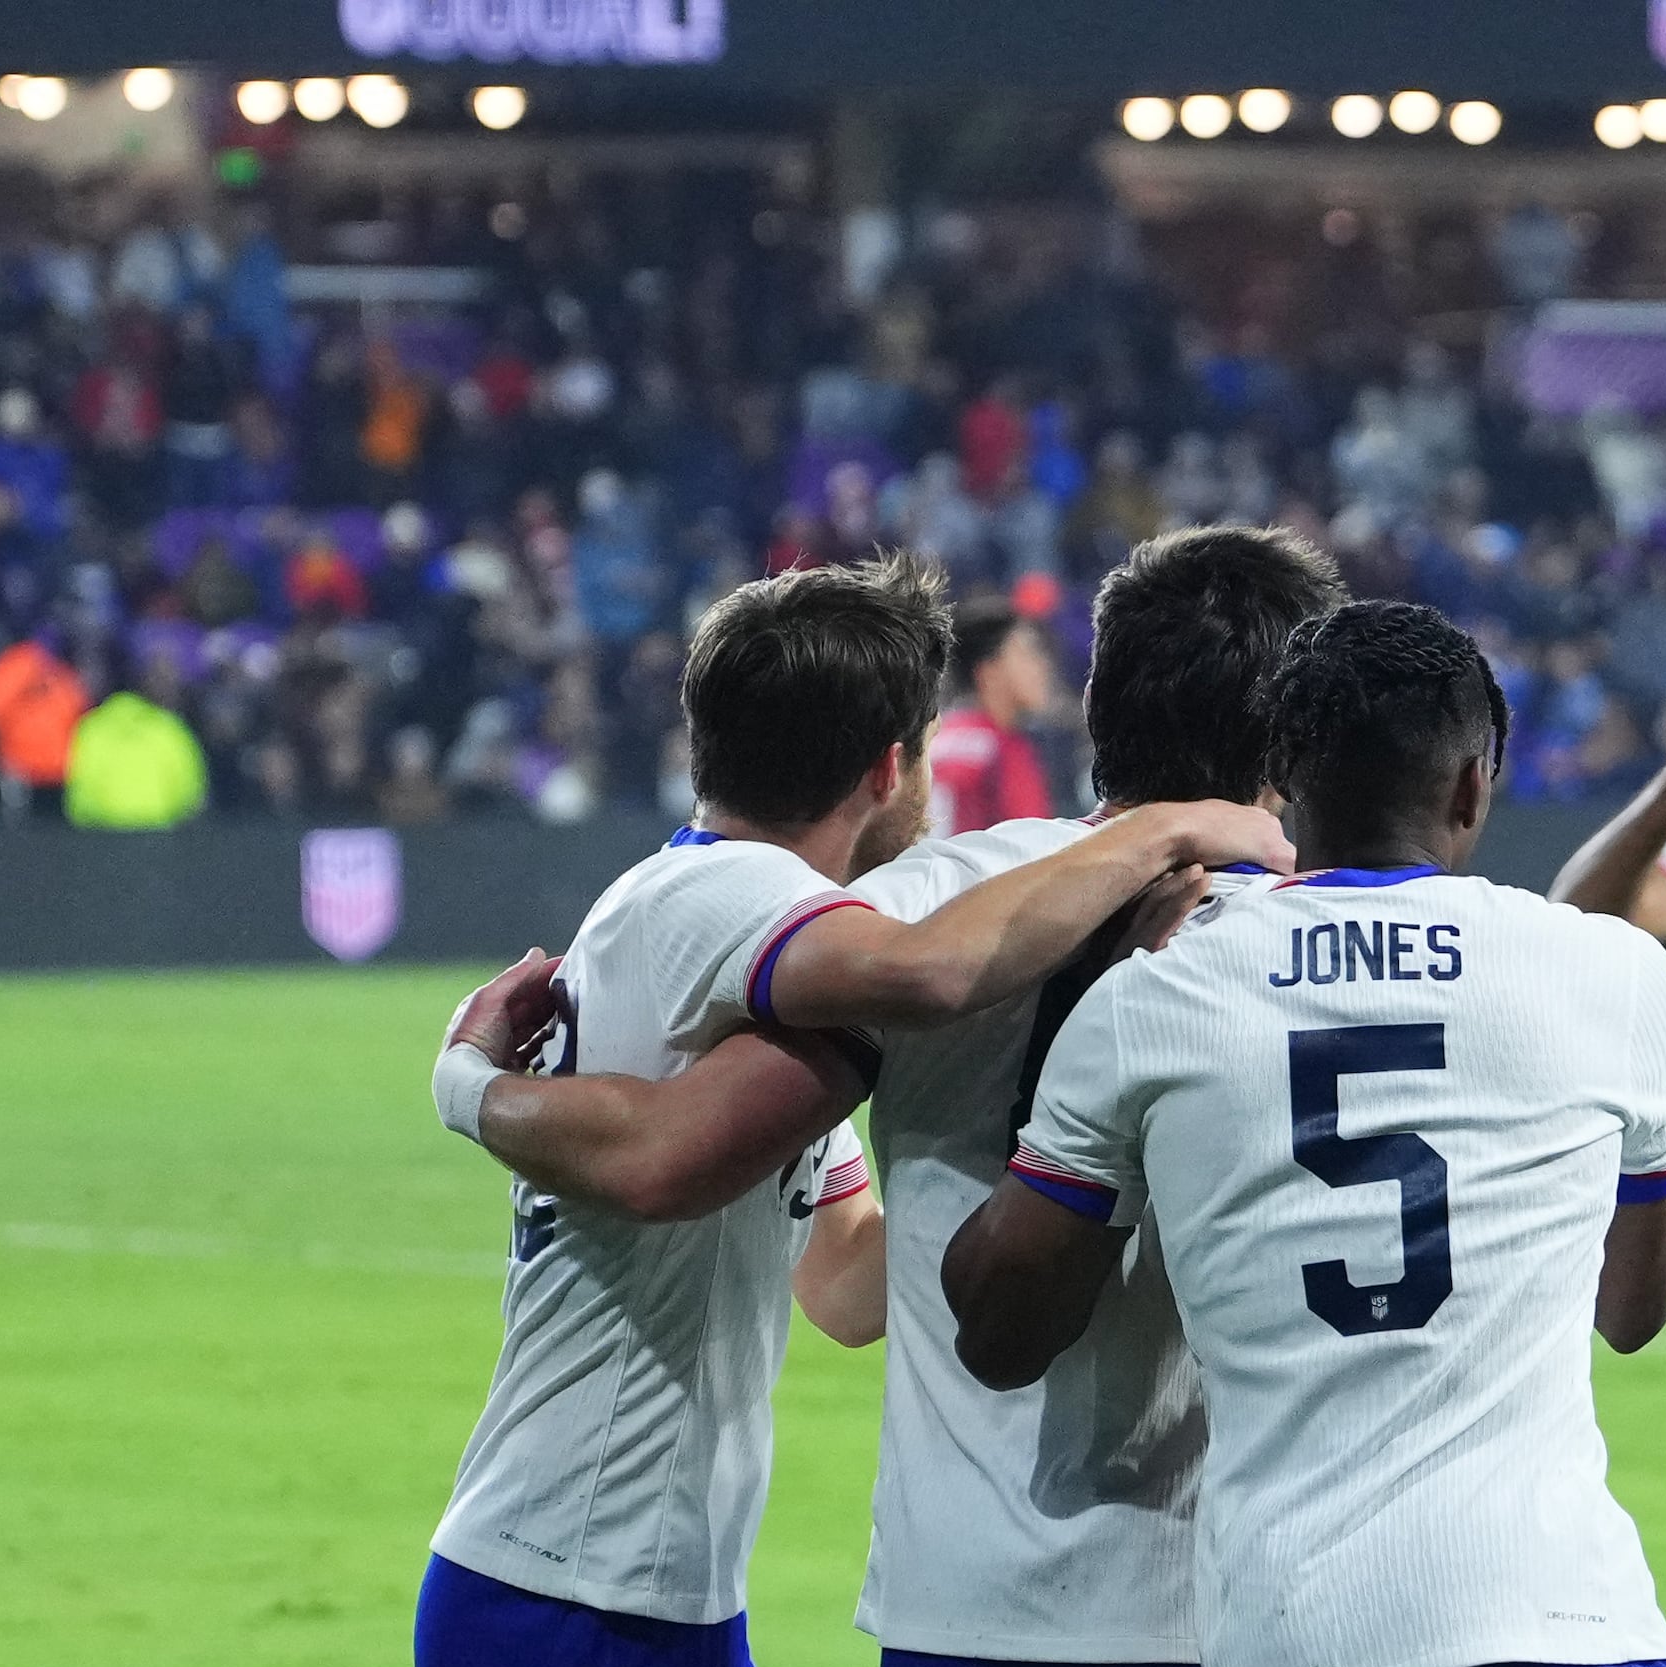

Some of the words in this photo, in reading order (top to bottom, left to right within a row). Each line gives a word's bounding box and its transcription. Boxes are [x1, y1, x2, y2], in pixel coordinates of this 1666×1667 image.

[1268, 920, 1462, 988] JONES
[1288, 1022, 1453, 1337] 5
[1371, 1296, 1388, 1307] USA
